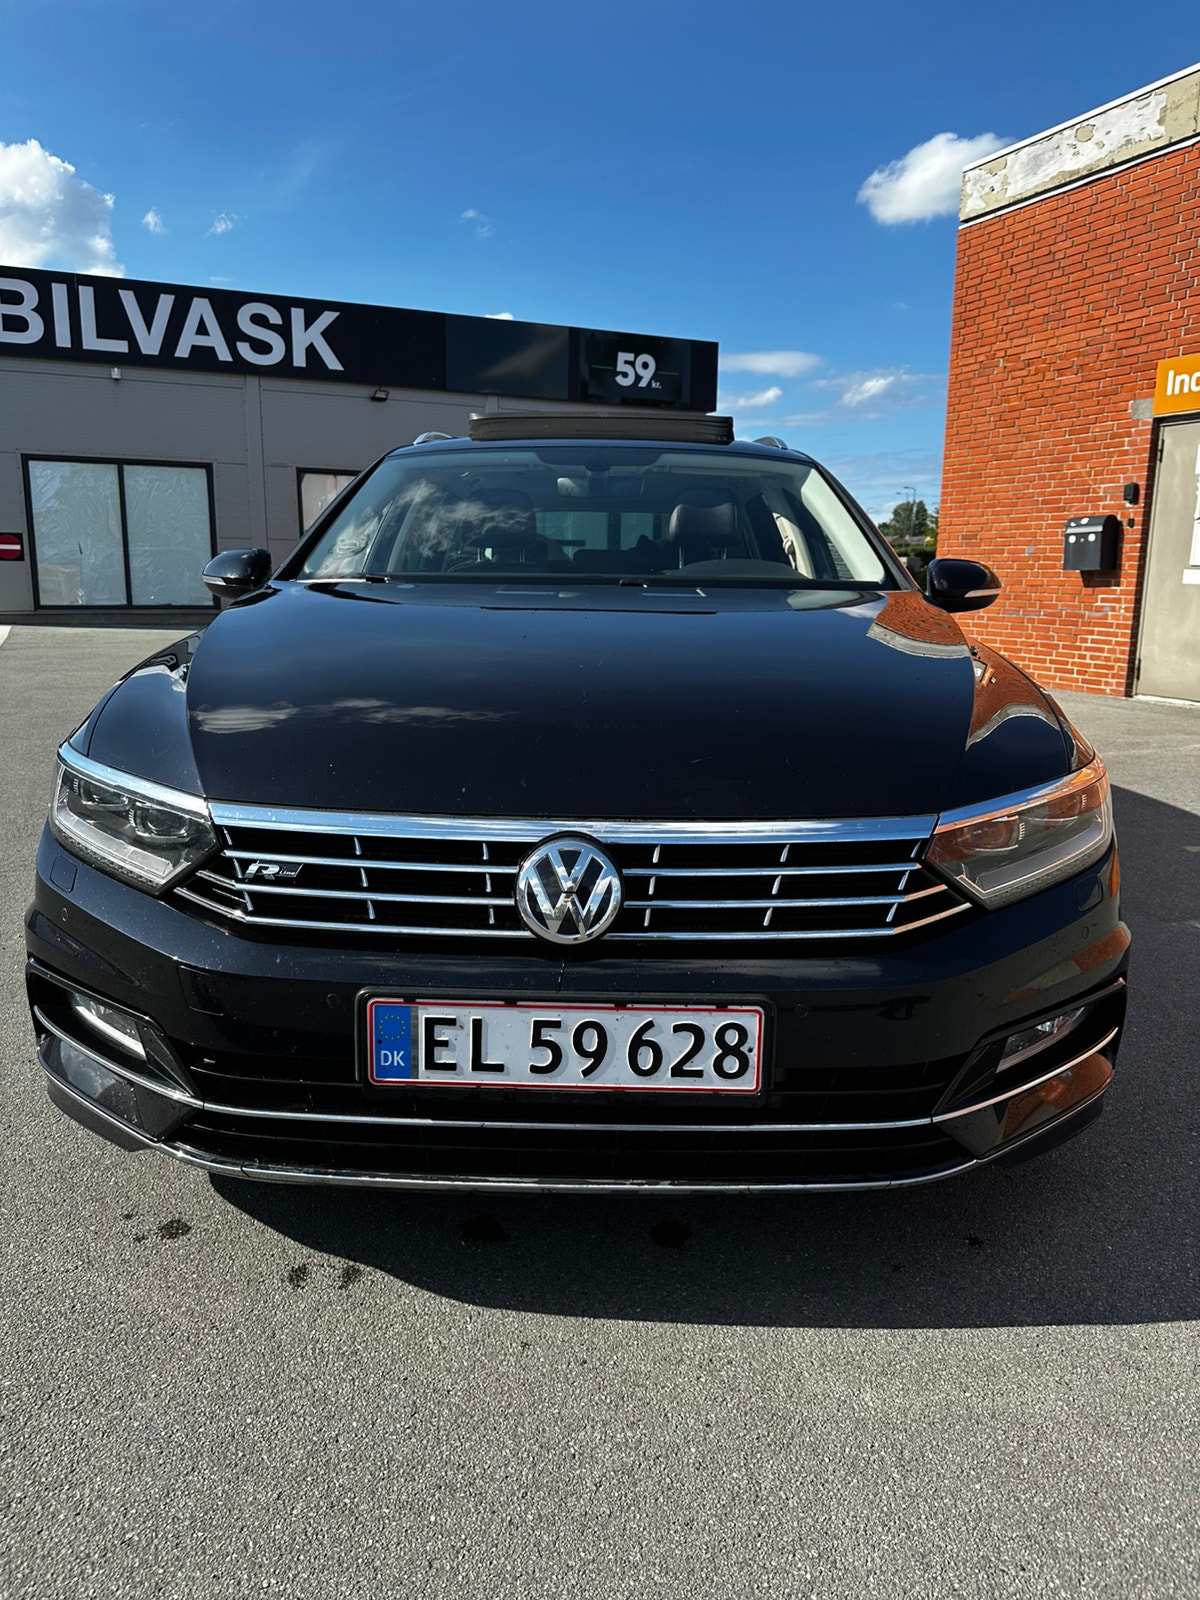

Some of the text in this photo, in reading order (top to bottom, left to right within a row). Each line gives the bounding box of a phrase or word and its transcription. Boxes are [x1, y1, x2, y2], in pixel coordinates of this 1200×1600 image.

[0, 277, 344, 371] BILVASK
[615, 351, 656, 387] 59
[380, 1050, 405, 1067] DK
[422, 1014, 750, 1080] EL 59 628
